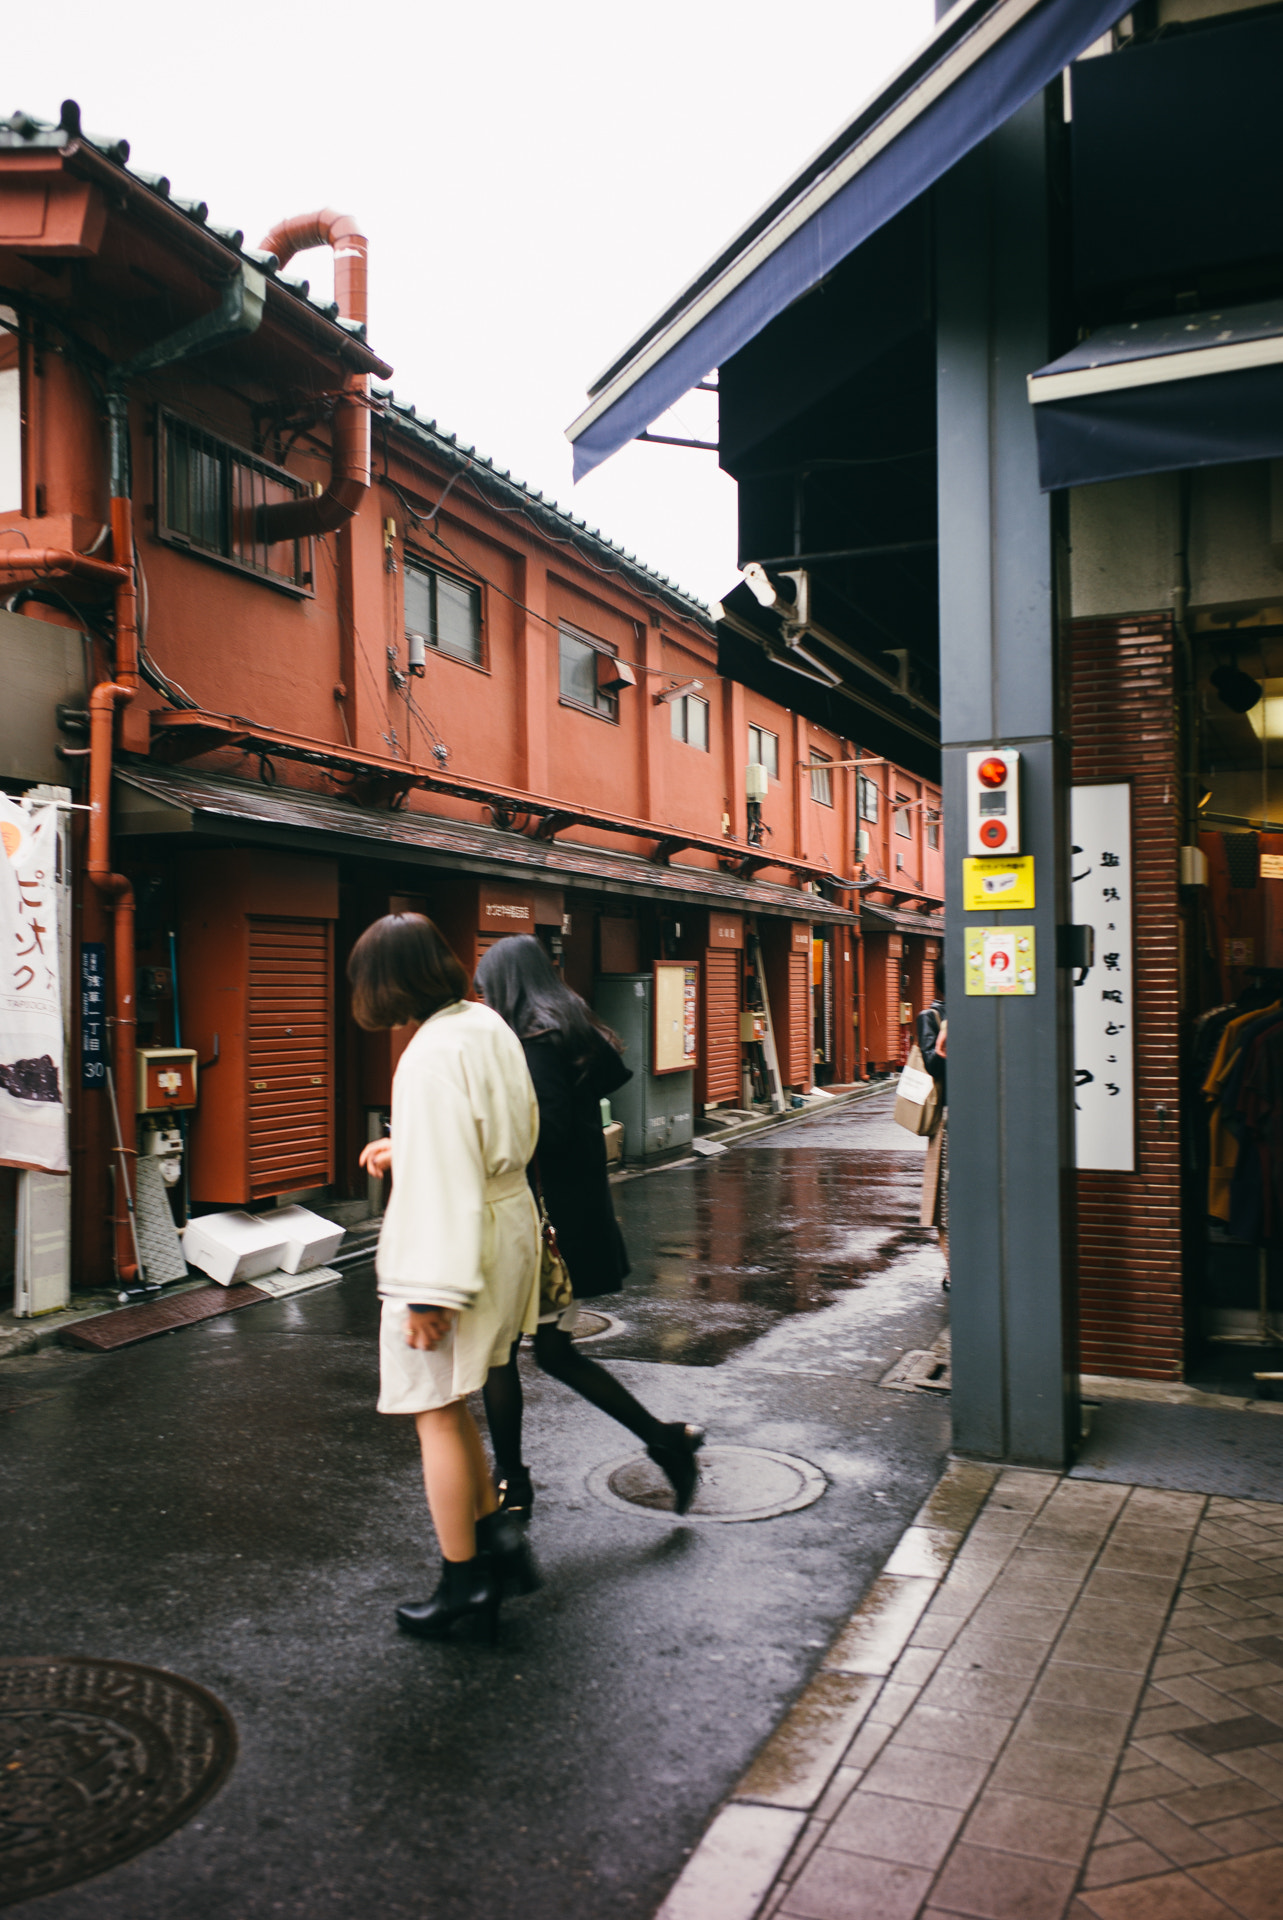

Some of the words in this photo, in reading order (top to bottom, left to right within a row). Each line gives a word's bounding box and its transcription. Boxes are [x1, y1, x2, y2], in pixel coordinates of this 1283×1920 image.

[1099, 851, 1126, 1097] 趣味の呉服どころ
[84, 1062, 104, 1078] 30
